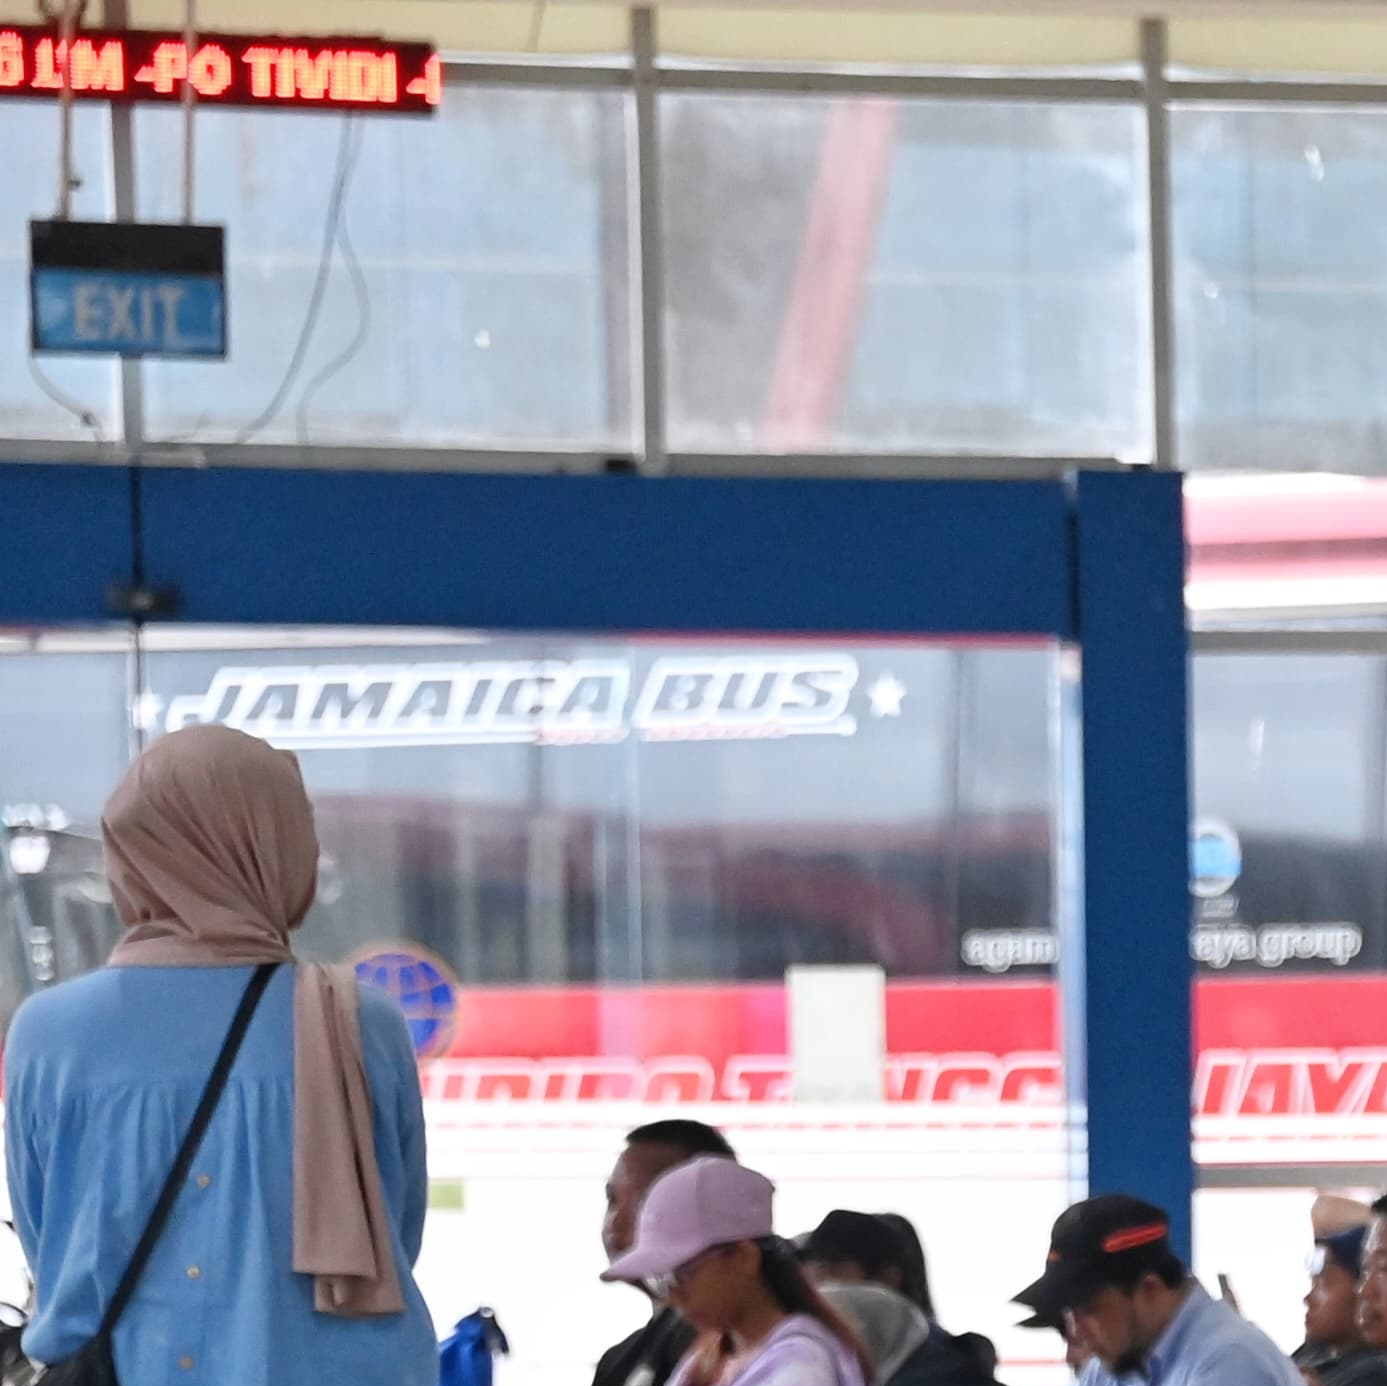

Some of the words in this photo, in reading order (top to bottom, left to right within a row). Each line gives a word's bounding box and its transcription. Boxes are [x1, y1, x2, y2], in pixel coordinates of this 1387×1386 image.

[73, 282, 185, 346] EXIT
[166, 660, 629, 733] JAMAICA
[631, 654, 858, 728] BUS
[1258, 925, 1362, 967] group
